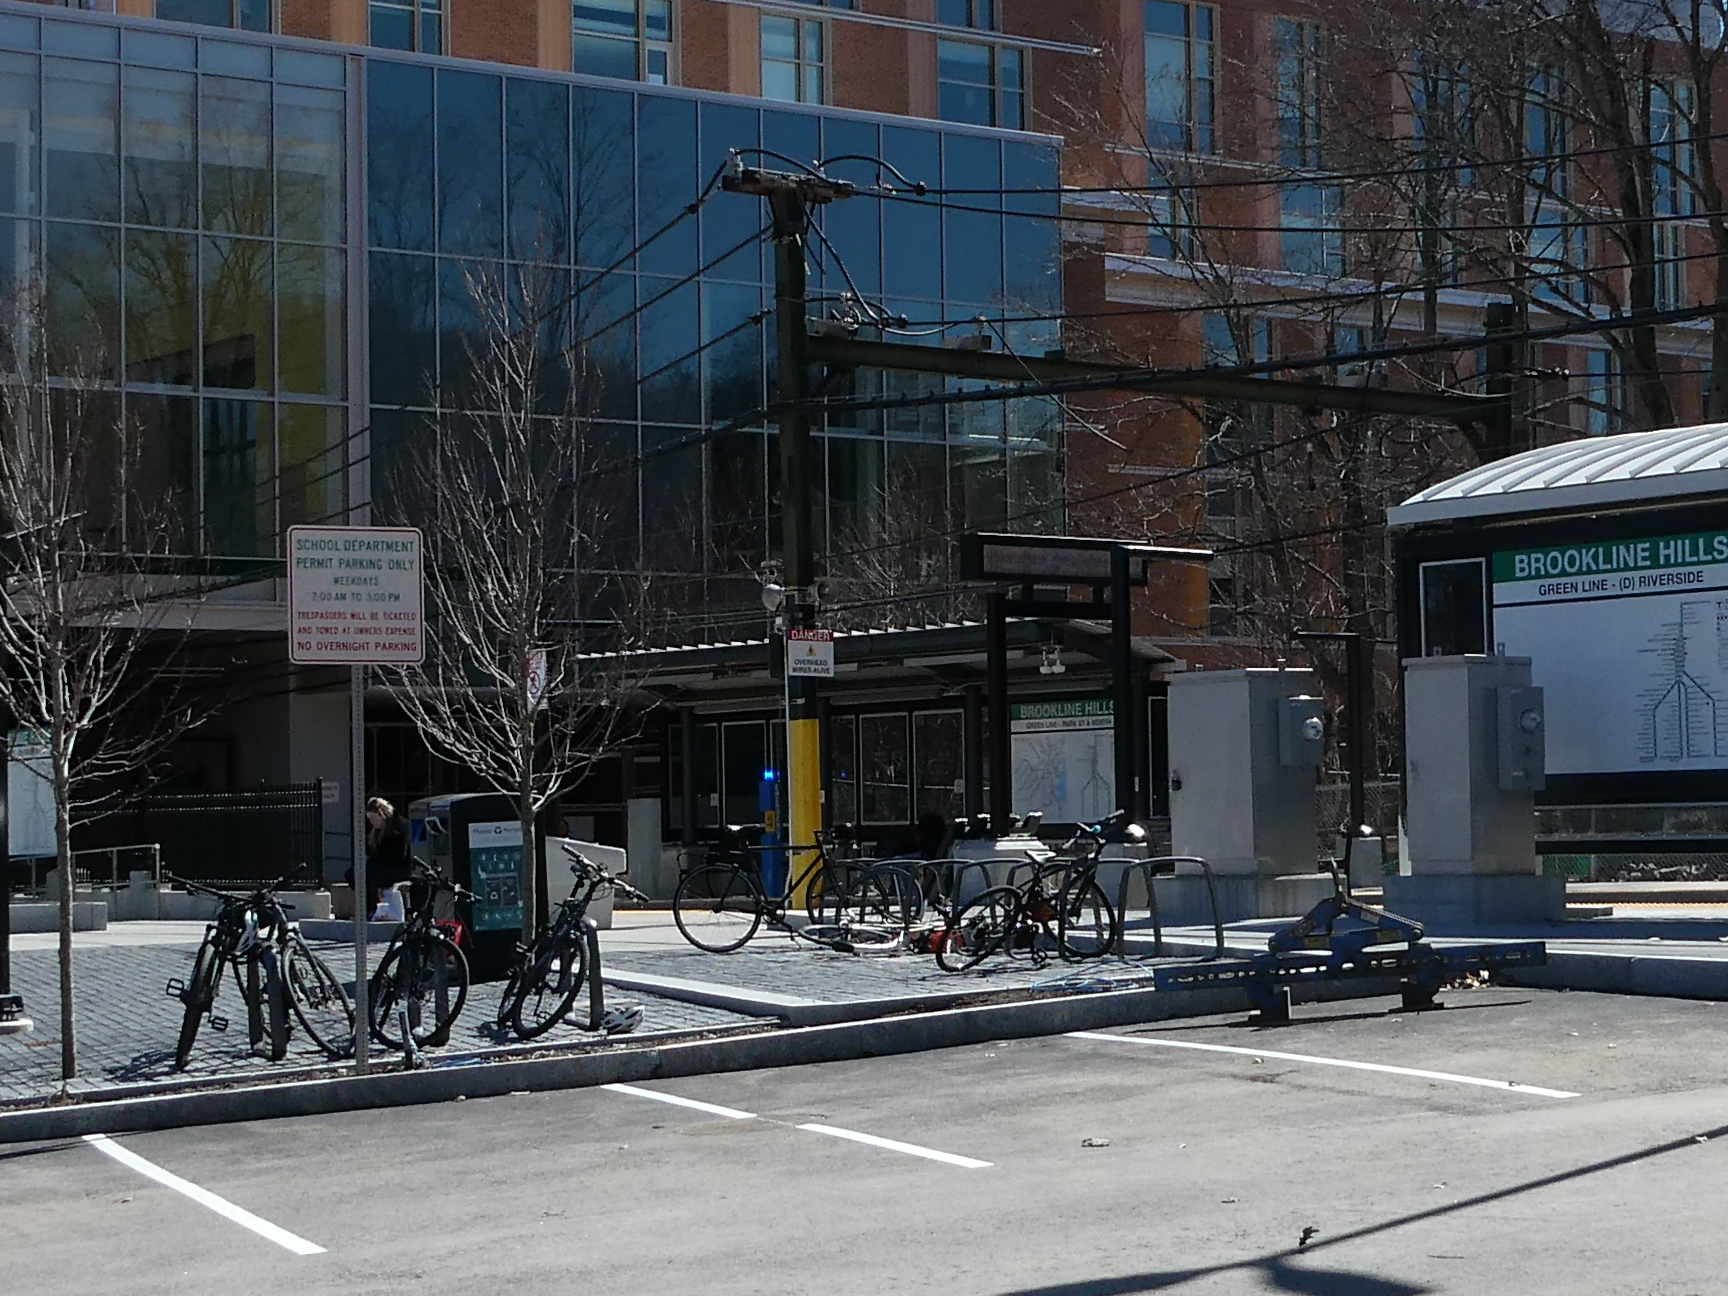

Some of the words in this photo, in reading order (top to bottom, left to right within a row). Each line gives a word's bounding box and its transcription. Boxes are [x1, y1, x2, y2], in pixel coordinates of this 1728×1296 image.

[297, 539, 339, 551] SCHOOL
[344, 540, 414, 552] DEPARTMENT
[1515, 542, 1651, 578] BROOKLINE
[1659, 535, 1728, 566] HILLS
[296, 558, 333, 569] PERMIT
[339, 558, 382, 570] PARKING
[388, 559, 415, 571] ONLY
[334, 577, 378, 586] WEEKDAYS
[1538, 582, 1579, 596] GREEN
[1582, 579, 1608, 593] LINE
[1619, 576, 1635, 592] (D)
[1639, 570, 1704, 588] RIVERSIDE
[334, 593, 346, 601] AM
[351, 593, 362, 601] TO
[388, 593, 400, 602] PM
[297, 611, 347, 620] TRESPASSERS
[350, 612, 366, 620] WILL
[370, 612, 380, 620] BE
[384, 612, 416, 621] TICKETED
[297, 627, 311, 635] AND
[316, 627, 339, 635] TOWED
[342, 627, 350, 635] AT
[354, 627, 382, 635] OWNERS
[385, 627, 416, 636] EXPENSE
[791, 629, 830, 641] DANGER
[297, 642, 311, 651] NO
[317, 642, 370, 651] OVERNIGHT
[375, 643, 416, 652] PARKING
[1021, 702, 1083, 718] BROOKLINE
